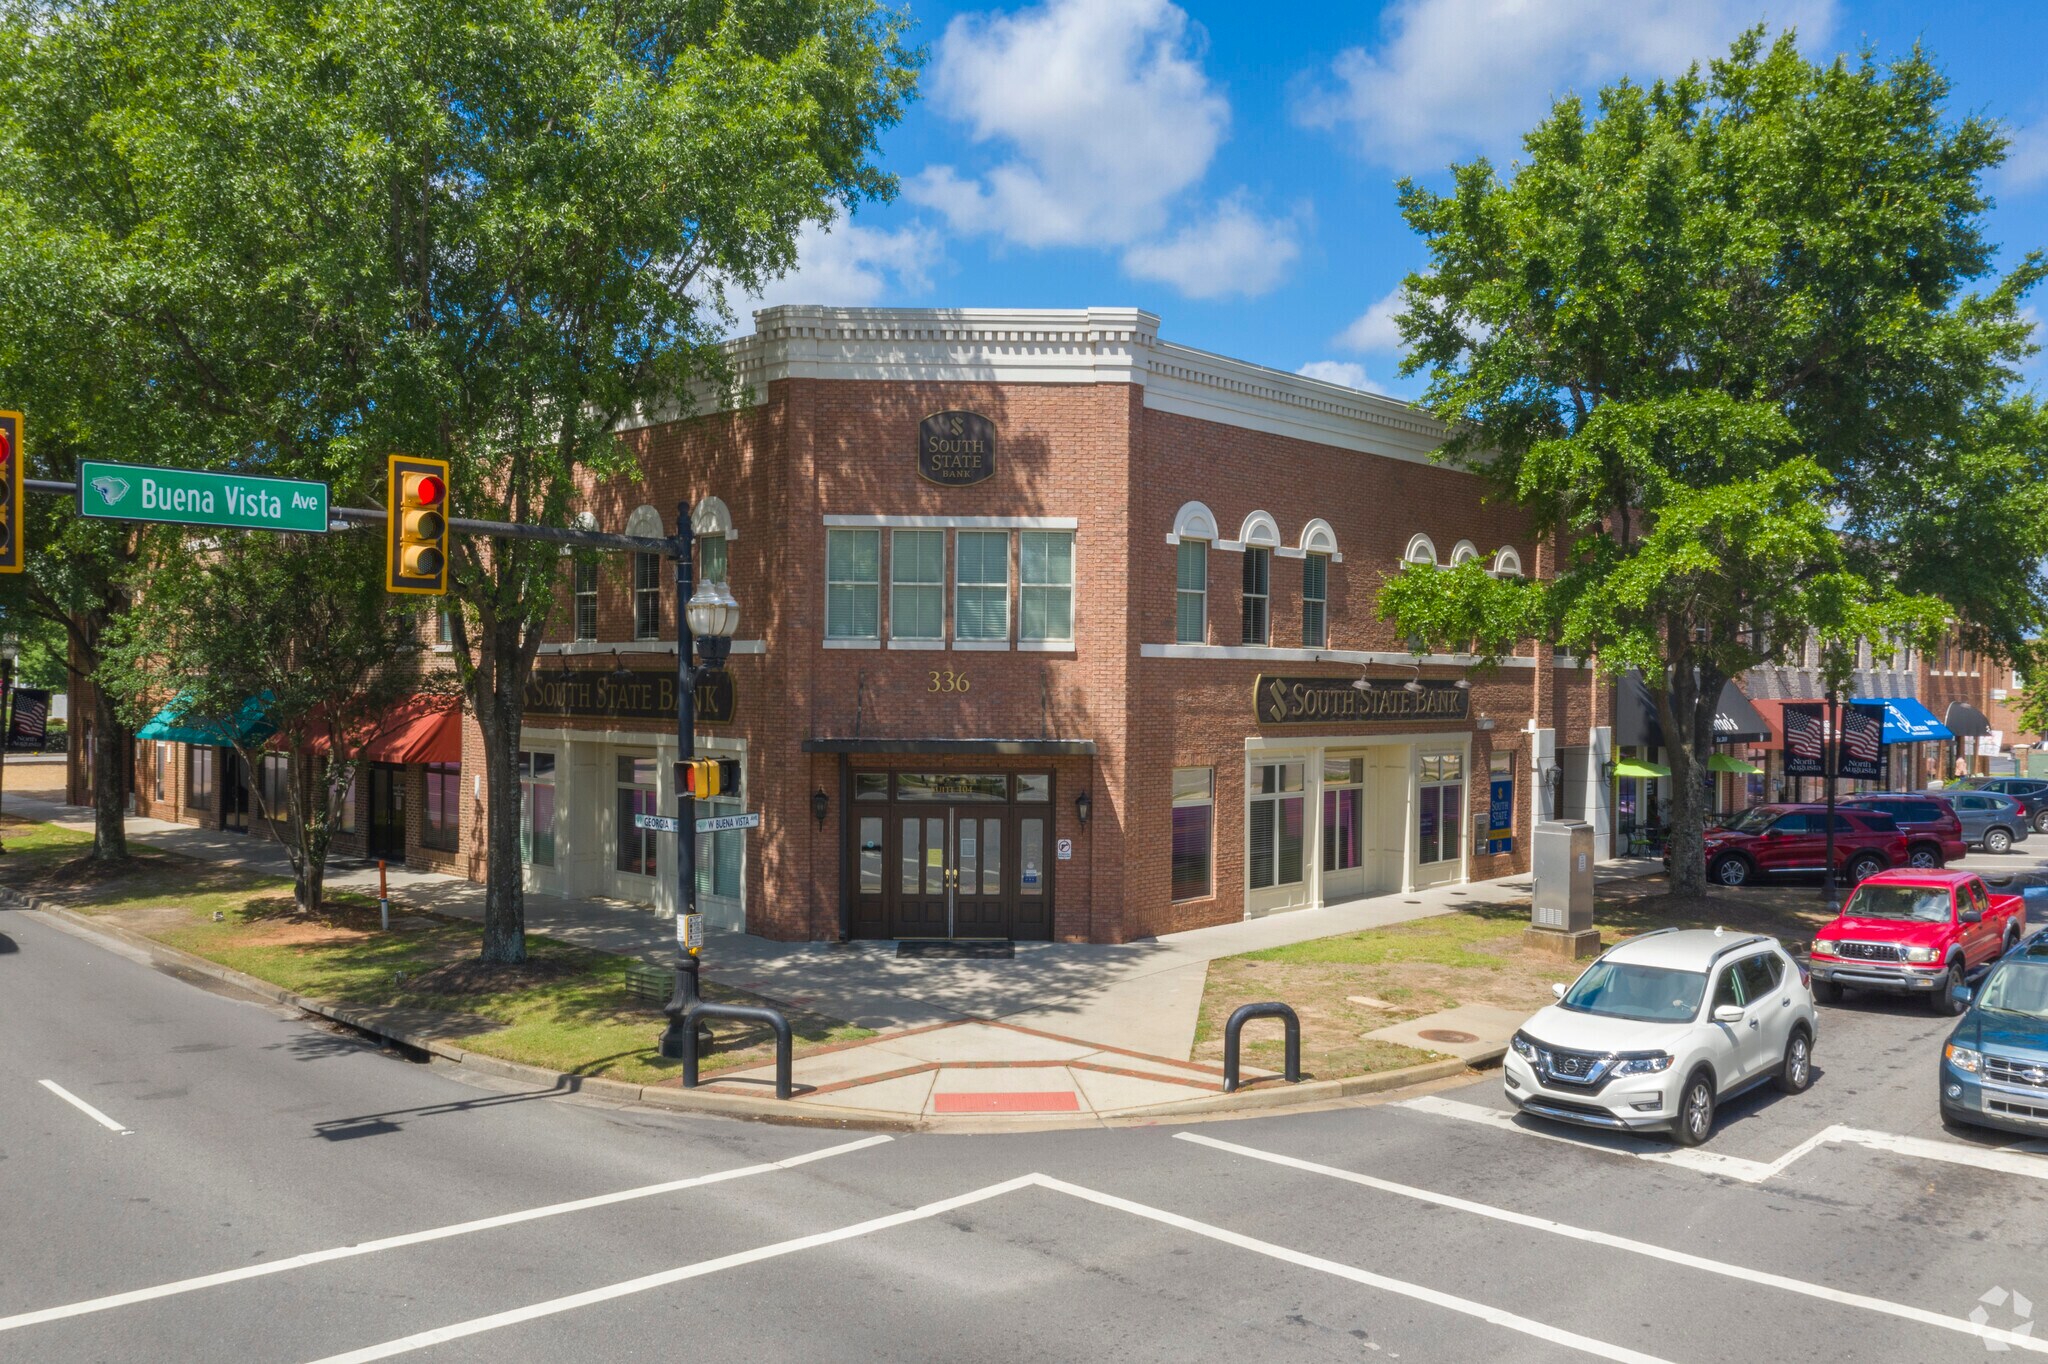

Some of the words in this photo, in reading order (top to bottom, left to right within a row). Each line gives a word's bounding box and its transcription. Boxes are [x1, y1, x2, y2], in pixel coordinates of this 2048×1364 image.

[929, 436, 984, 453] SOUTH
[931, 454, 982, 471] STATE
[943, 470, 971, 478] BANK
[141, 479, 214, 514] Buena
[225, 485, 281, 519] Vista
[291, 491, 318, 511] Ave
[927, 670, 970, 693] 336
[534, 676, 590, 708] SOUTH
[596, 676, 651, 710] STATE
[1292, 683, 1356, 716] SOUTH
[1359, 687, 1410, 715] STATE
[1414, 686, 1461, 713] BANK
[1787, 764, 1821, 772] Augusta
[1842, 765, 1877, 775] Augusta
[1848, 760, 1872, 768] North
[1492, 801, 1509, 812] SOUTH
[708, 819, 715, 829] W
[715, 818, 734, 829] BUENA
[735, 816, 750, 826] VISTA
[1492, 810, 1508, 823] STATE
[644, 817, 669, 830] GEORGIA
